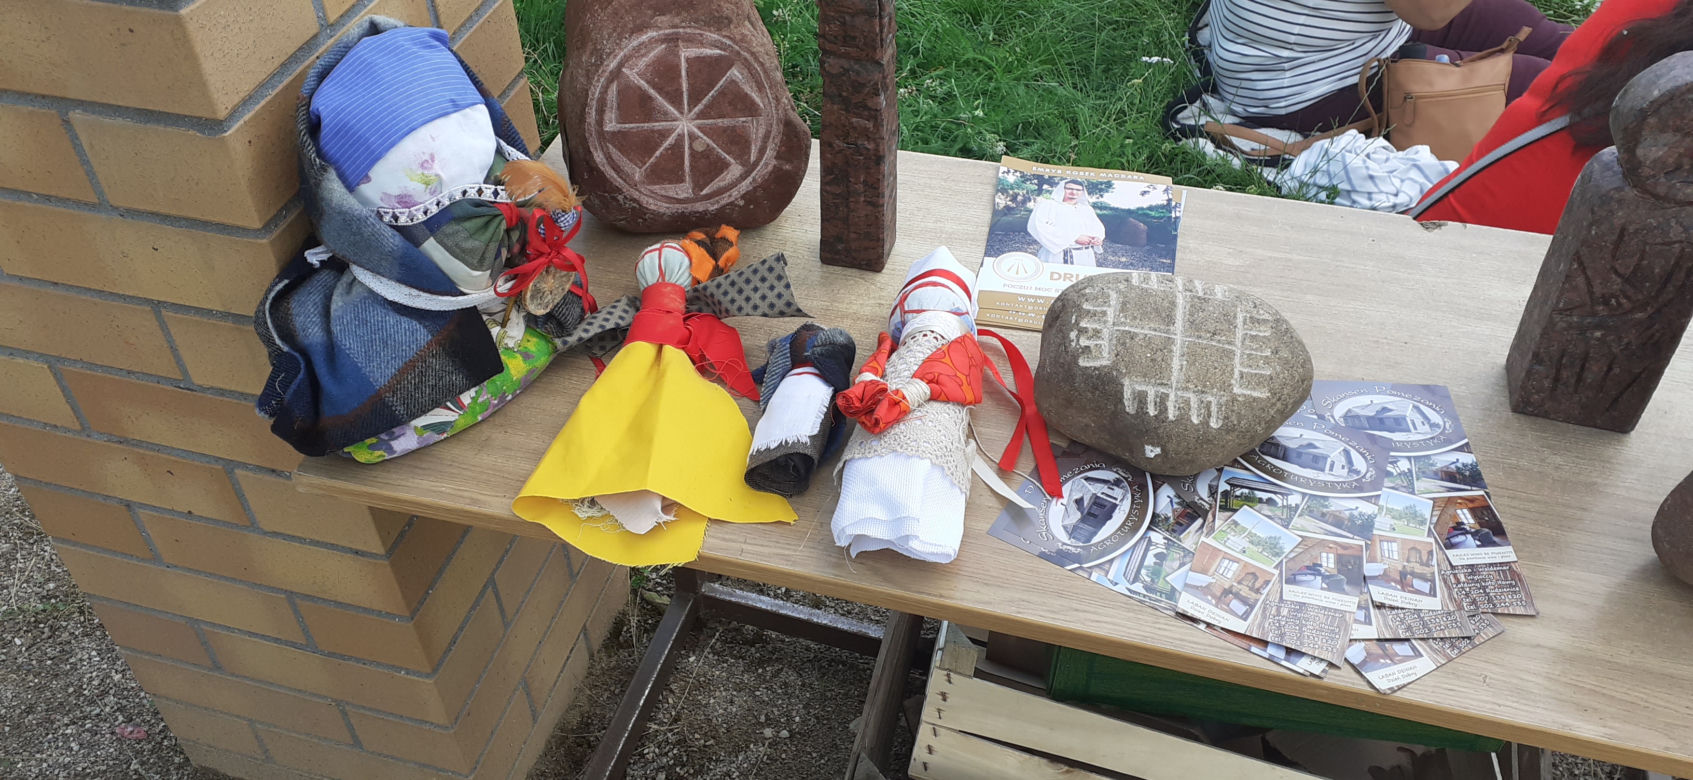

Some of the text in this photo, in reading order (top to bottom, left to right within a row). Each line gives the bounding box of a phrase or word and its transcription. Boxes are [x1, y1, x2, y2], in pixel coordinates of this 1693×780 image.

[1321, 385, 1446, 416] Skansen Pomezania
[1312, 422, 1376, 464] Pomezania
[1059, 459, 1107, 483] mezania
[1249, 453, 1361, 490] AGROTURYSTYKA
[1036, 497, 1055, 542] Skansen
[1090, 484, 1144, 553] AGROTURYSTYKA
